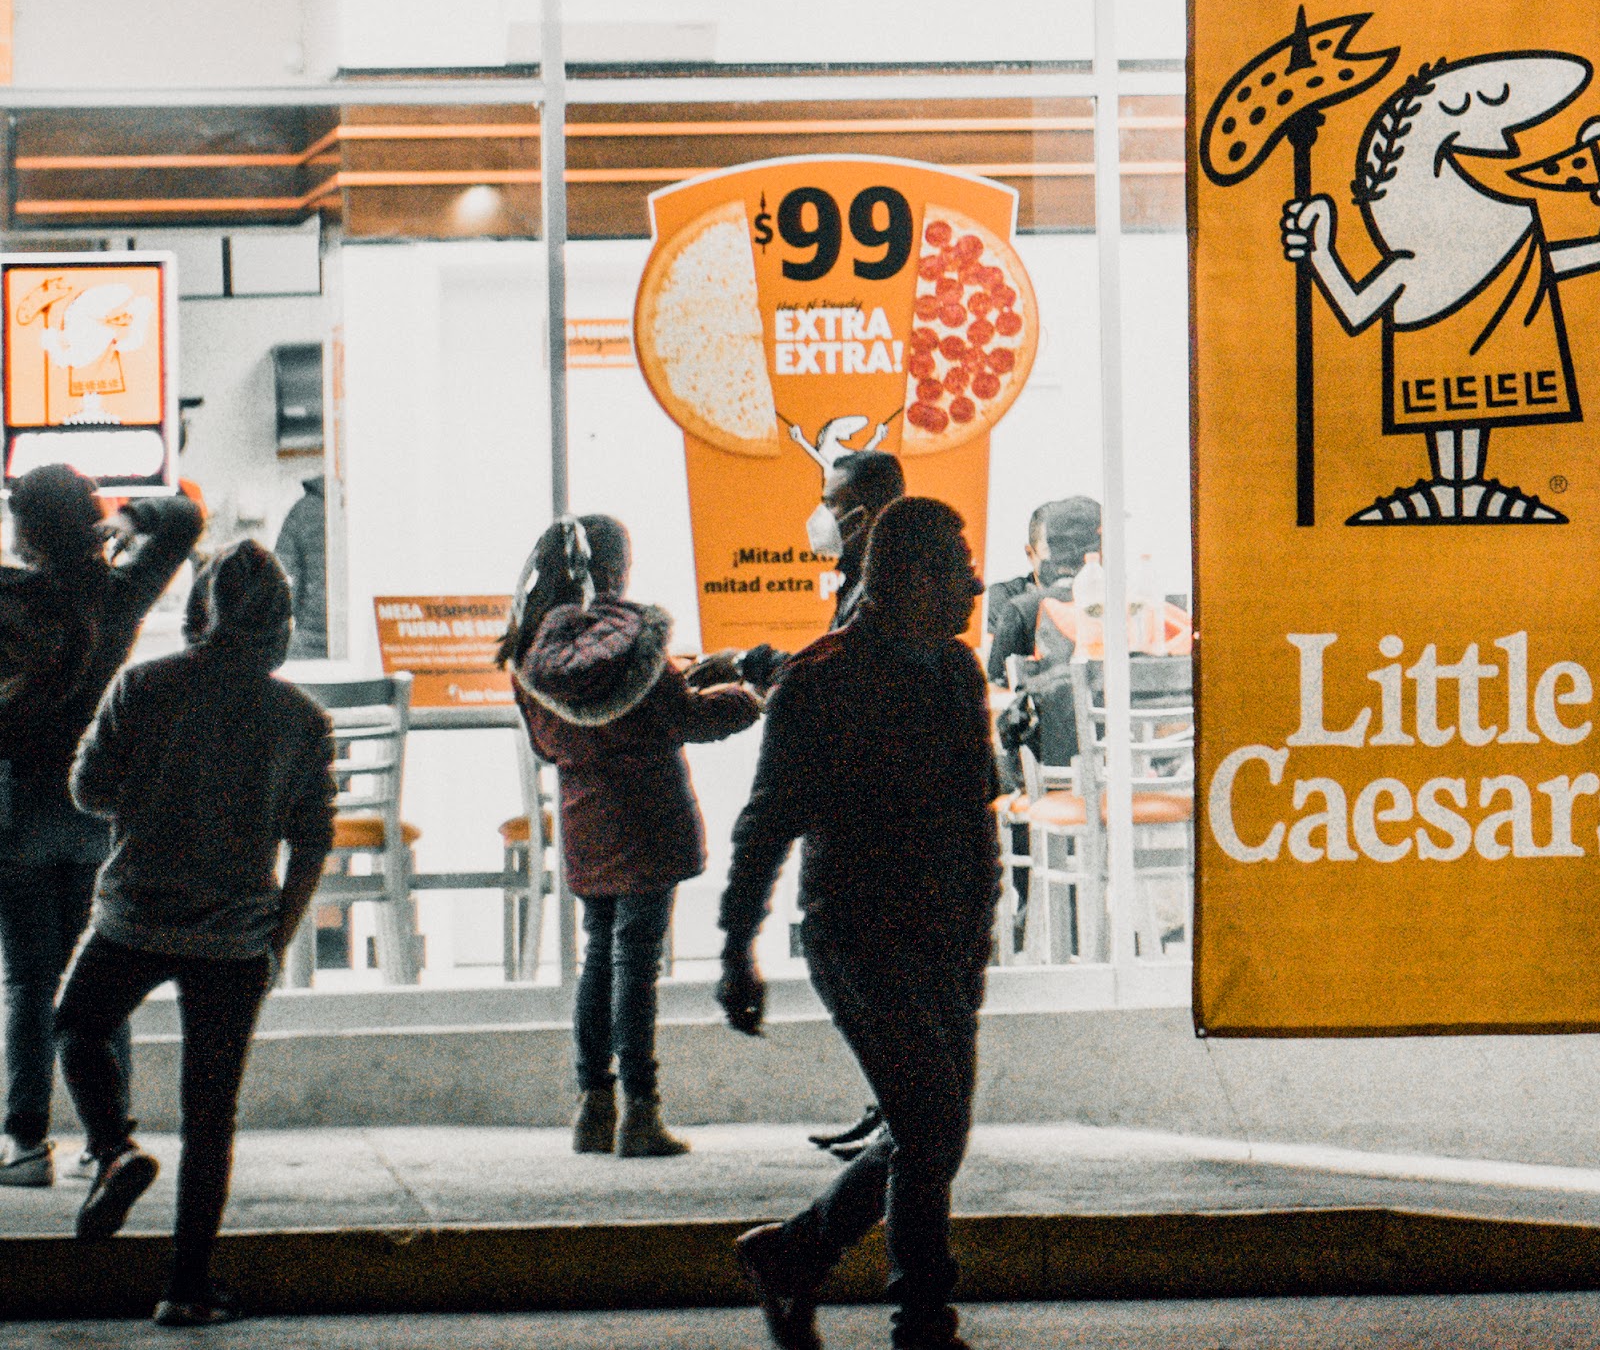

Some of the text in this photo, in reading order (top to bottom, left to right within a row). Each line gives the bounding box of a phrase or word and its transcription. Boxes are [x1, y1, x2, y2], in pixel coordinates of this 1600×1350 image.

[754, 185, 914, 282] $99
[775, 306, 893, 342] EXTRA
[775, 340, 904, 376] EXTRA!
[732, 546, 794, 568] ¡Mitad
[704, 576, 761, 593] mitad
[765, 578, 814, 592] extra
[1285, 630, 1594, 748] Little
